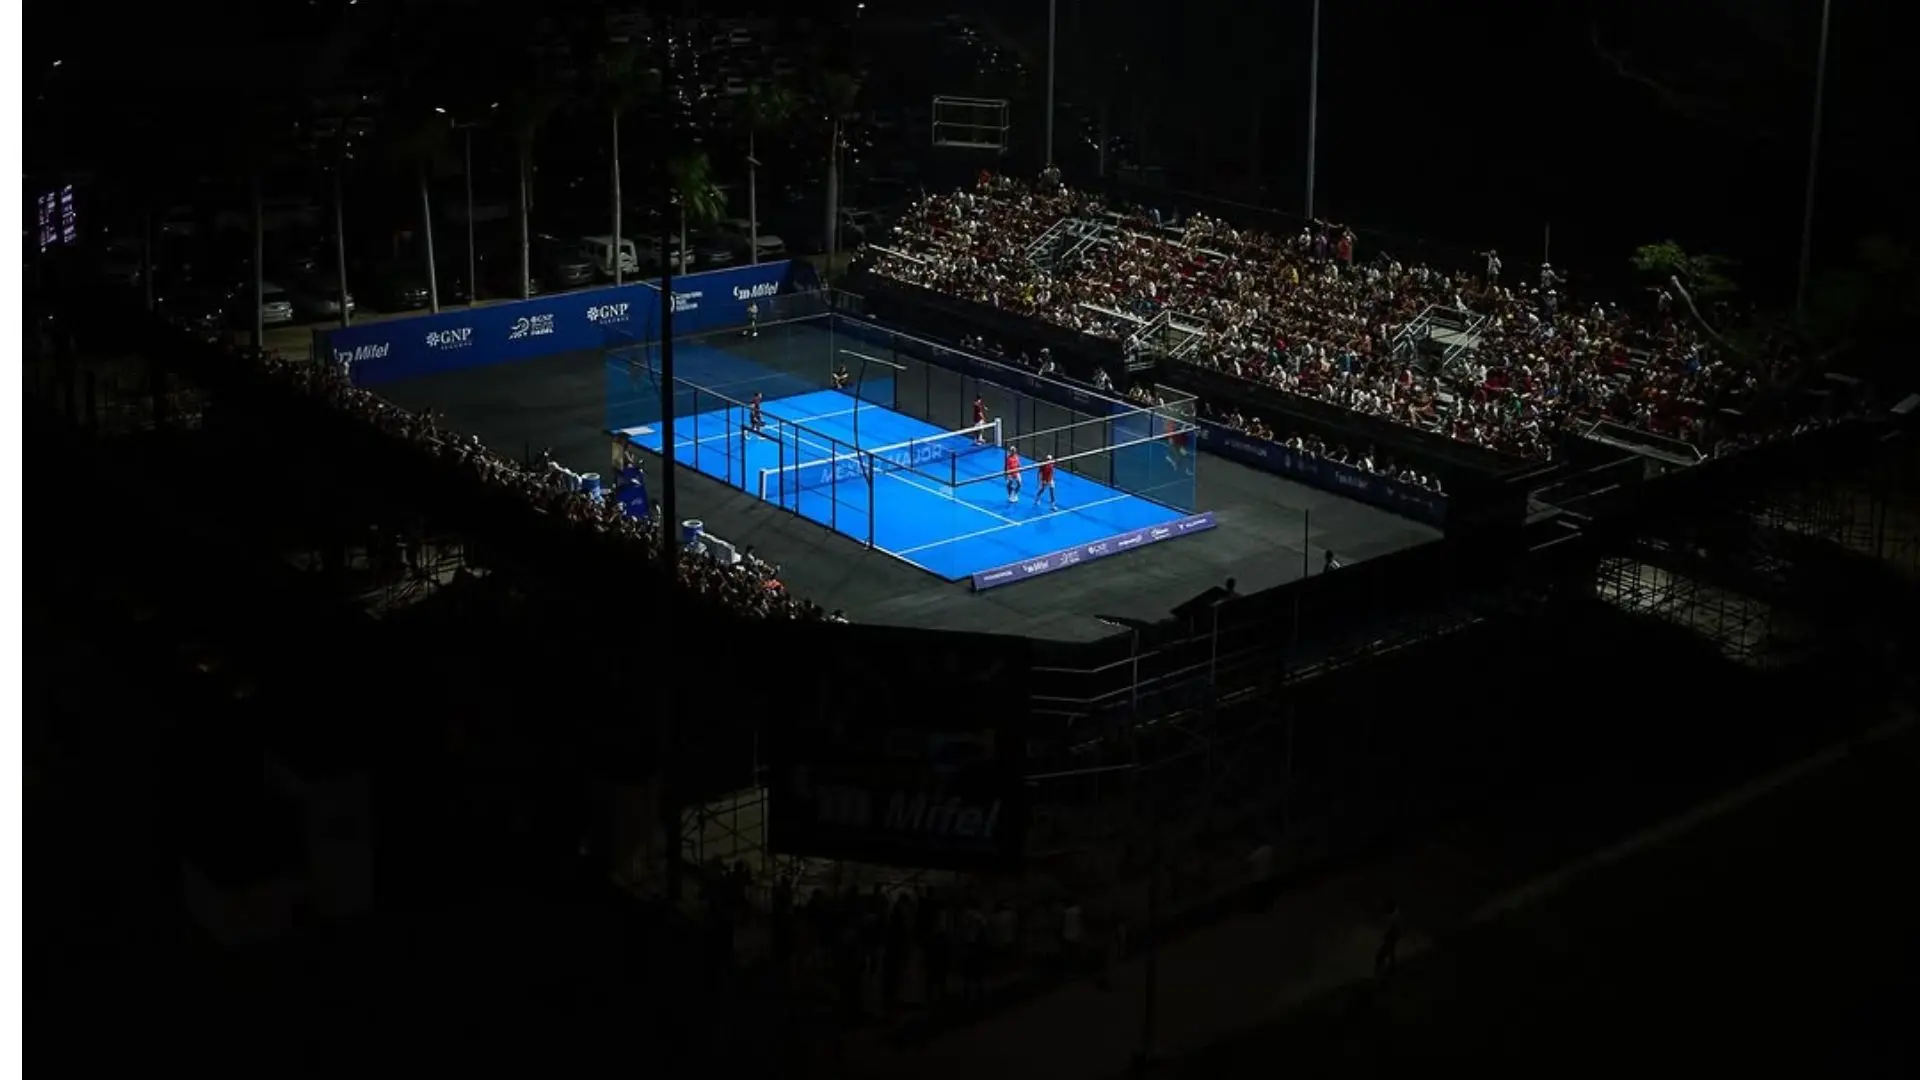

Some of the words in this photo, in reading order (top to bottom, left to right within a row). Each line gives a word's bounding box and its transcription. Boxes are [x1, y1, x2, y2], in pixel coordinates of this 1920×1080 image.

[750, 280, 779, 298] Mifel
[599, 302, 631, 319] GNP
[440, 327, 474, 344] GNP
[354, 341, 390, 361] Mifel
[884, 785, 1002, 838] Mifel
